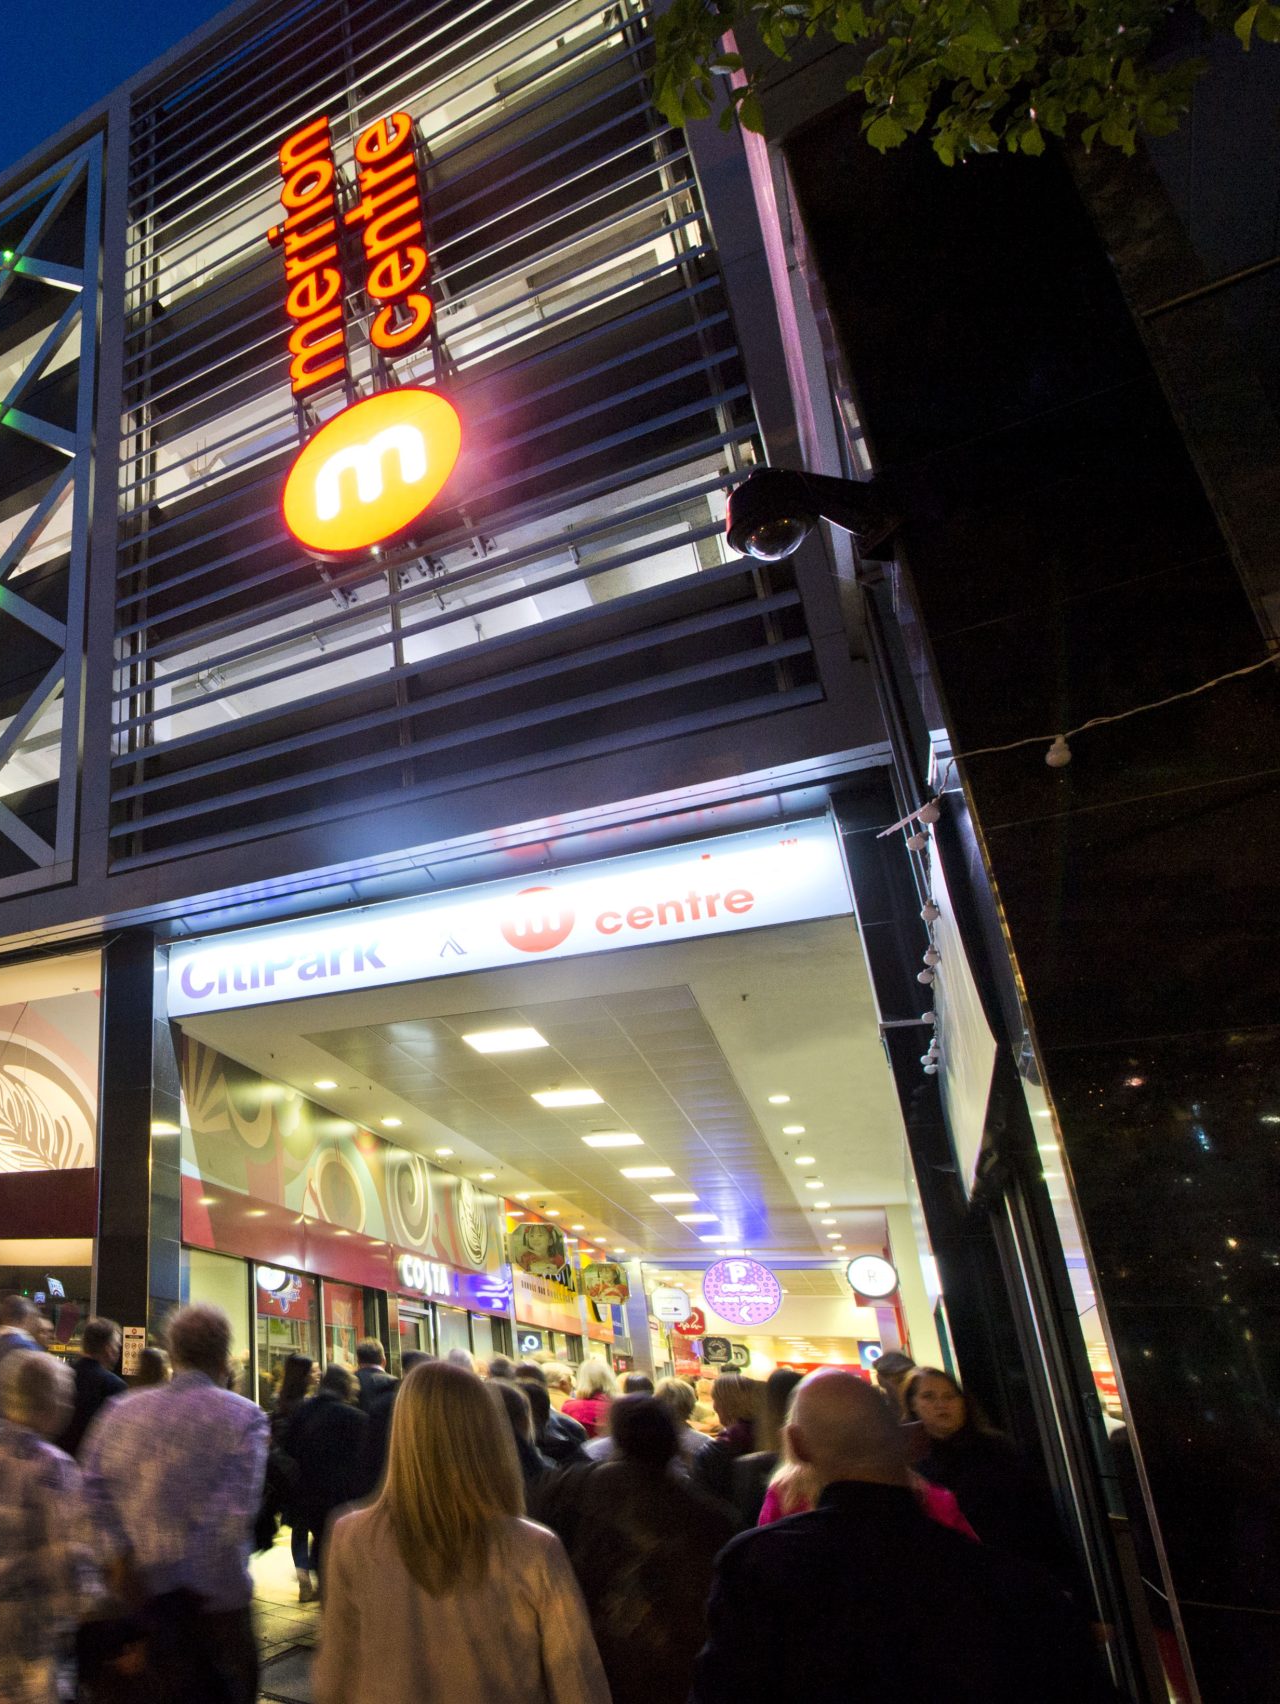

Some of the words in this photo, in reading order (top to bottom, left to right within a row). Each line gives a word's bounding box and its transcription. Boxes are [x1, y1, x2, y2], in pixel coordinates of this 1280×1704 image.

[269, 116, 347, 396] merrion
[345, 112, 433, 356] centre
[315, 424, 427, 521] m
[595, 888, 755, 935] centre
[401, 1254, 450, 1297] COSTA
